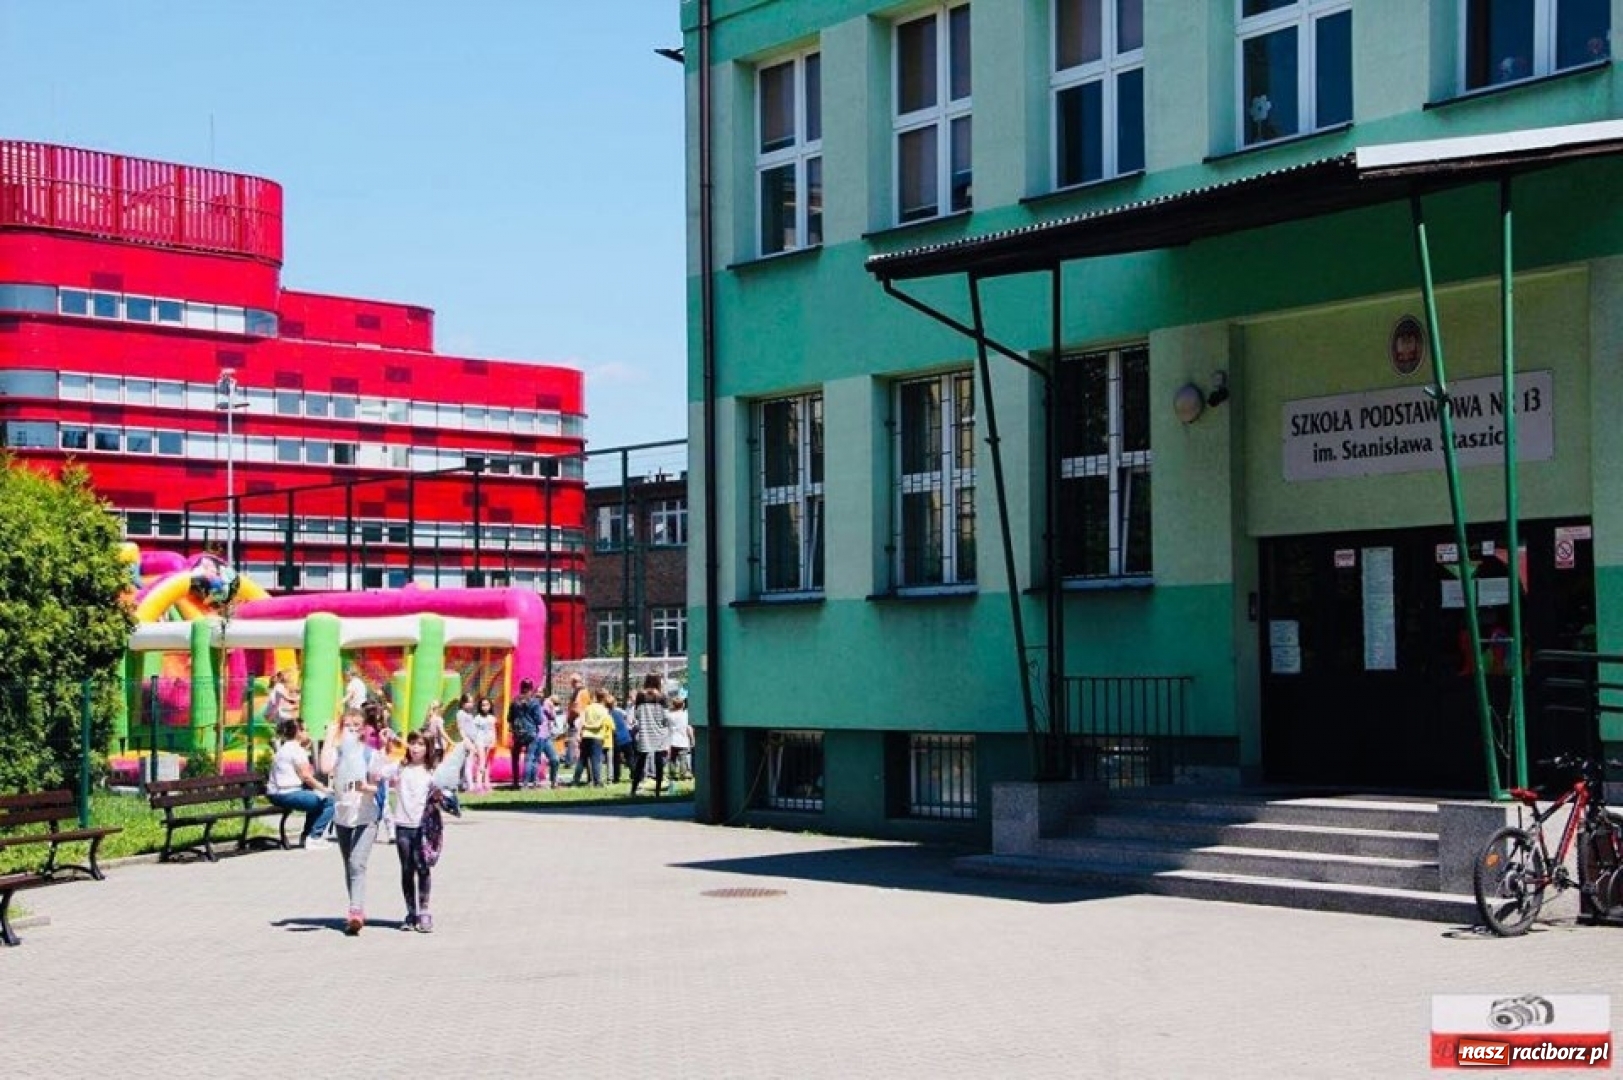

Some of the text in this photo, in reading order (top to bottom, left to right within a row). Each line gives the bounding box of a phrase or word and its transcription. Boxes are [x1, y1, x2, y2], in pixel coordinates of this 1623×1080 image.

[1291, 409, 1353, 436] SZKOŁA
[1490, 391, 1517, 416] N
[1523, 386, 1541, 412] 13
[1313, 442, 1337, 463] im.
[1342, 435, 1433, 460] Stanisława
